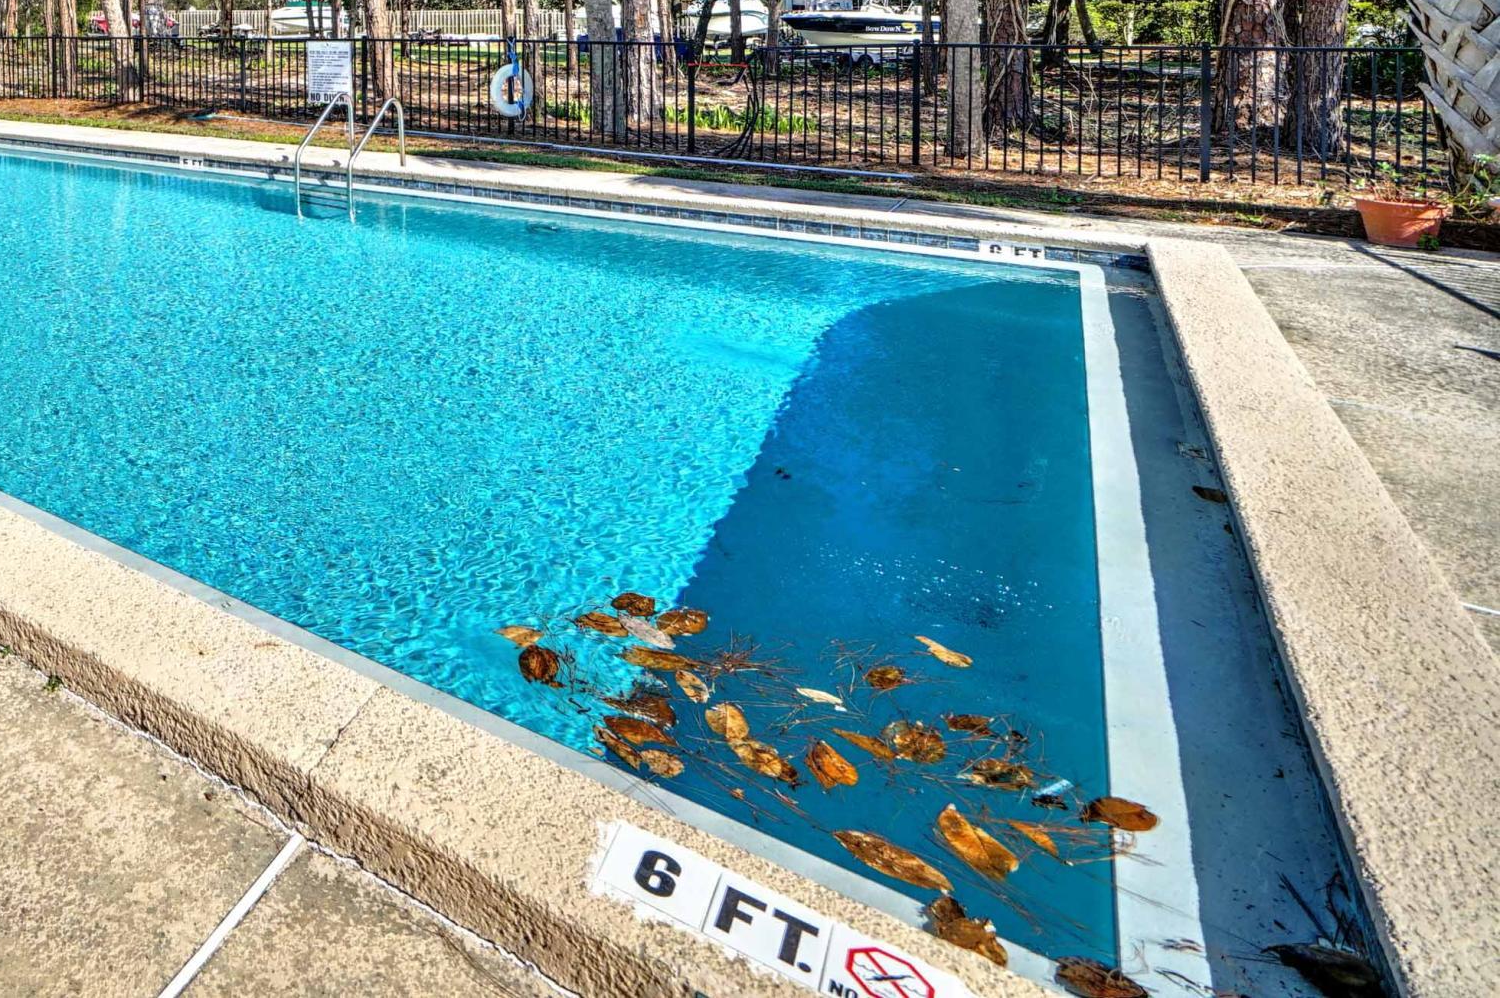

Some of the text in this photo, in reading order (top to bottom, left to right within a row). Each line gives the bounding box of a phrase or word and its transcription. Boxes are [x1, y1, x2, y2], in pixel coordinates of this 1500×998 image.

[310, 92, 321, 102] NO
[633, 850, 820, 974] 6 FT.
